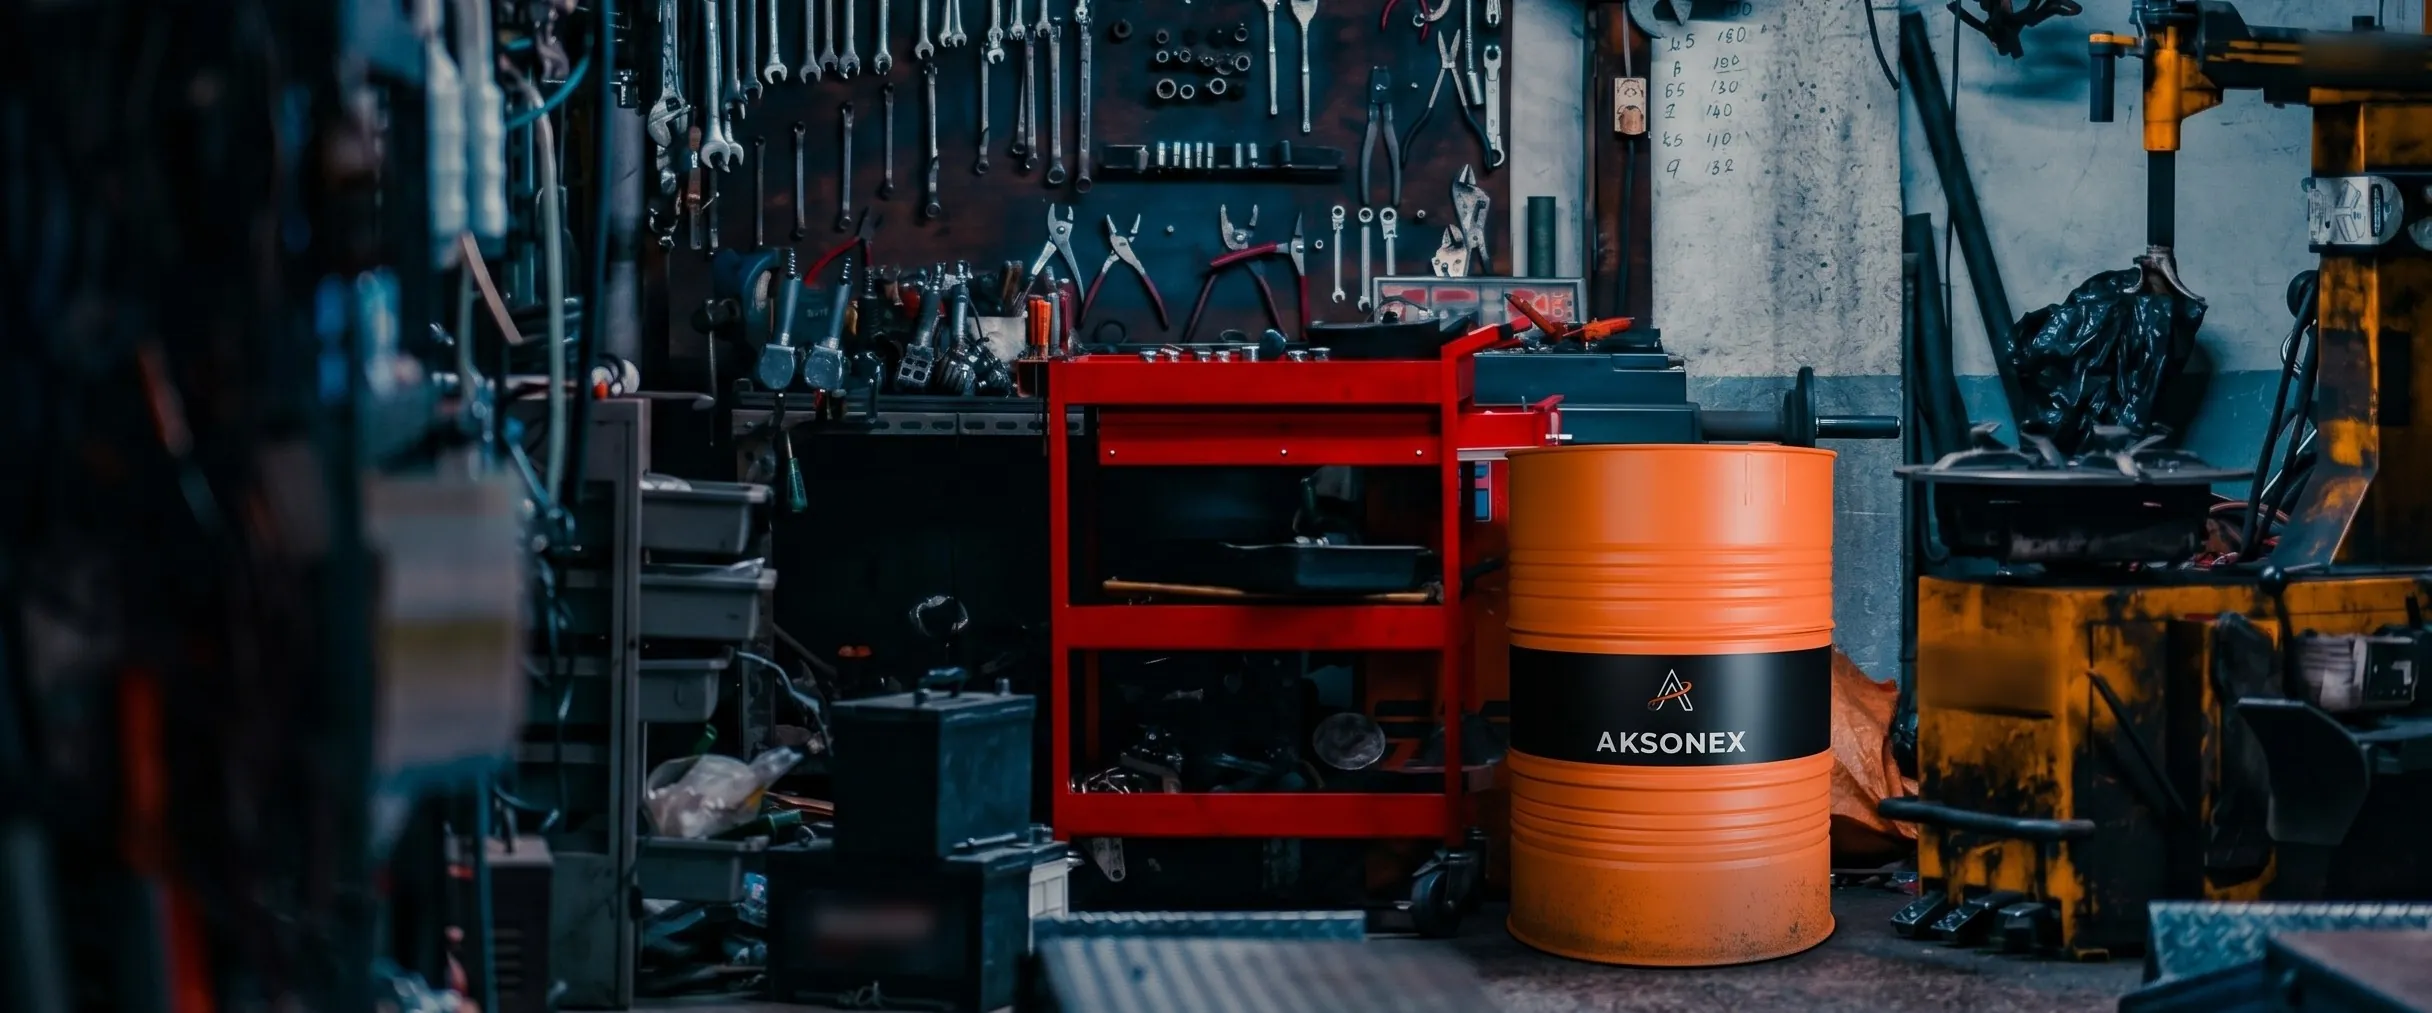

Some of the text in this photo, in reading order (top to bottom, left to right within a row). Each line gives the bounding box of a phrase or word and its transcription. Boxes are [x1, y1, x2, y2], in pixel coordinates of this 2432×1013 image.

[1710, 80, 1739, 95] 130
[1706, 103, 1733, 119] 140
[1704, 158, 1734, 176] 132
[1596, 730, 1747, 755] AKSONEX
